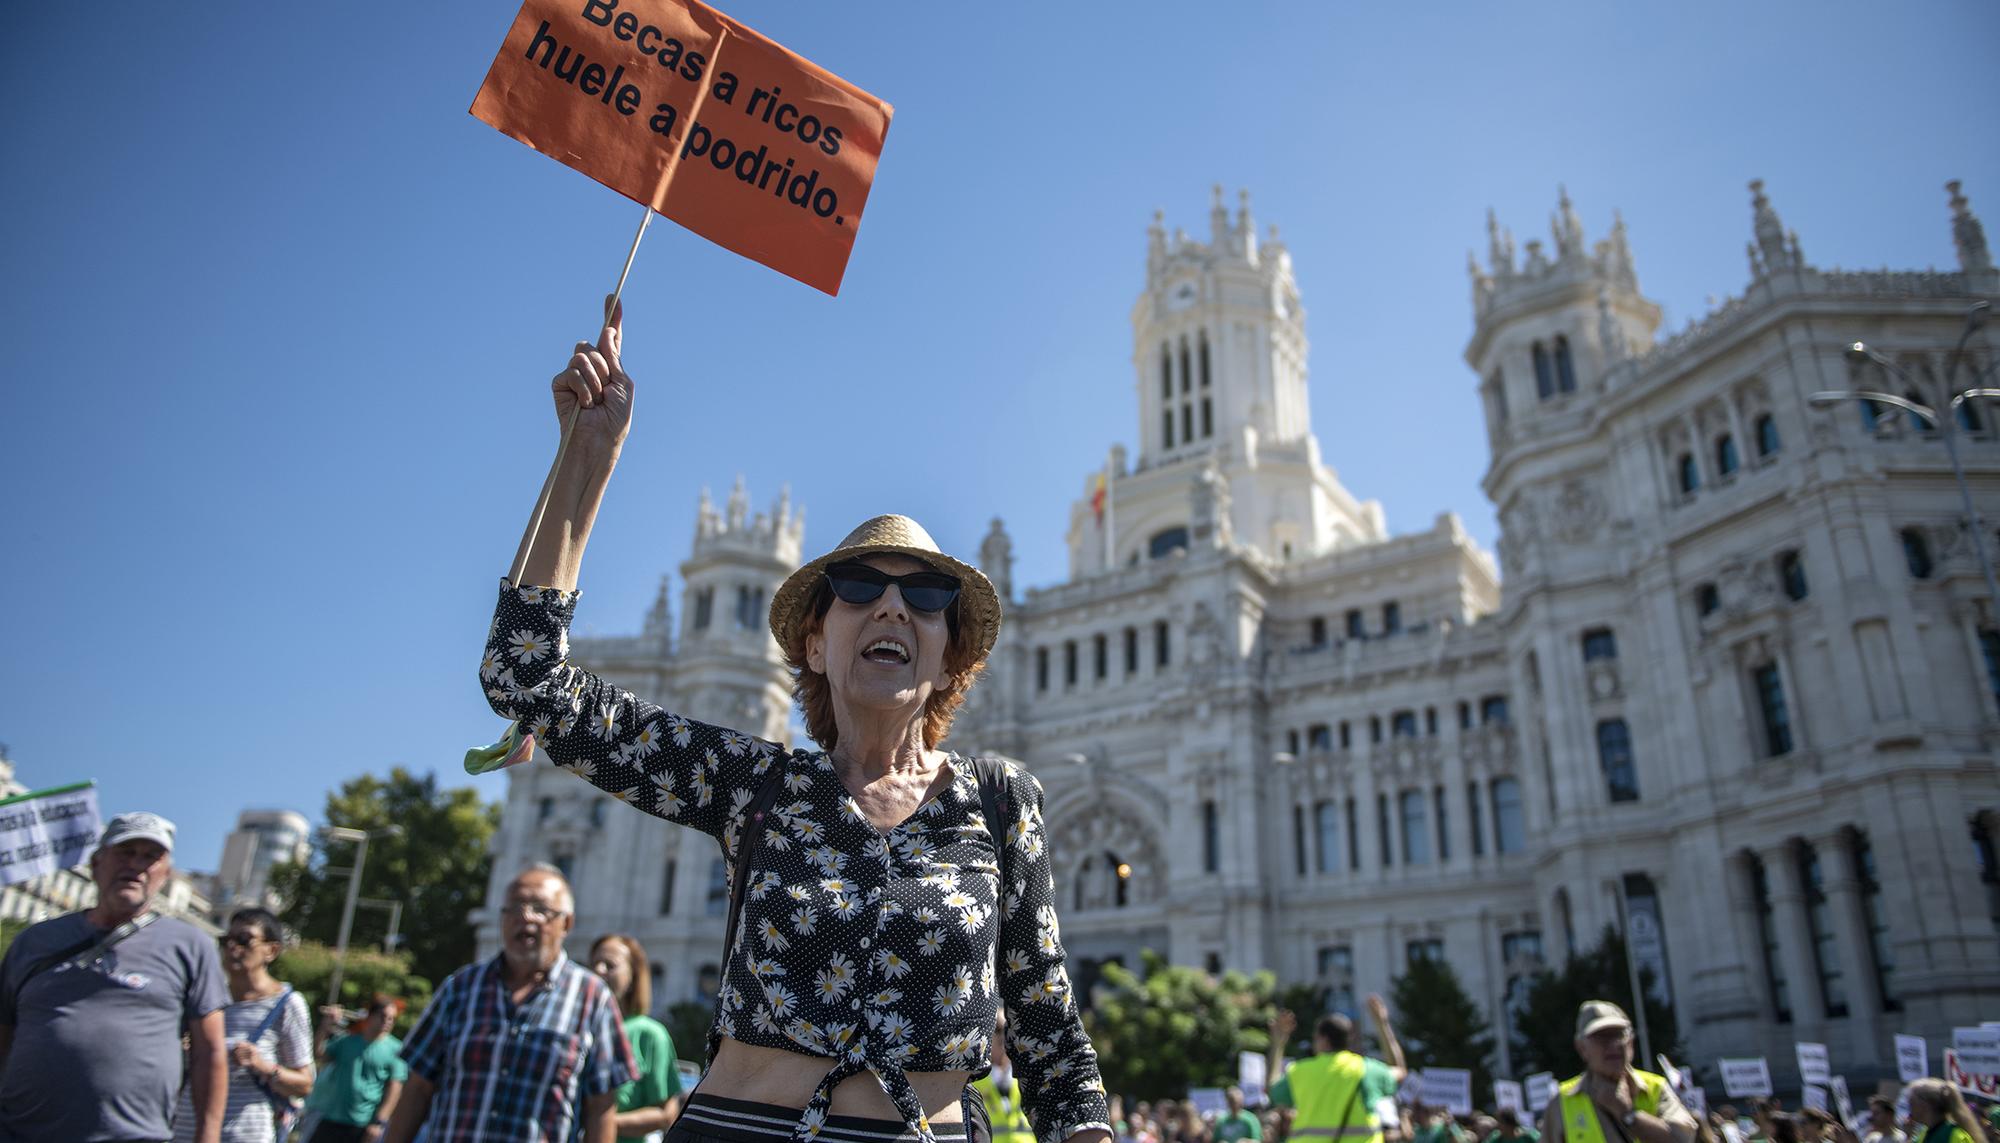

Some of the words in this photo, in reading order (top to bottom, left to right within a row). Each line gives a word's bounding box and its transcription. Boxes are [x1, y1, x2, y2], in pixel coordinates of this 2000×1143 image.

[525, 19, 641, 116] huele
[649, 103, 677, 138] a
[681, 120, 844, 226] podrido.
[581, 0, 706, 82] Becas
[712, 71, 739, 105] a
[745, 86, 843, 156] ricos
